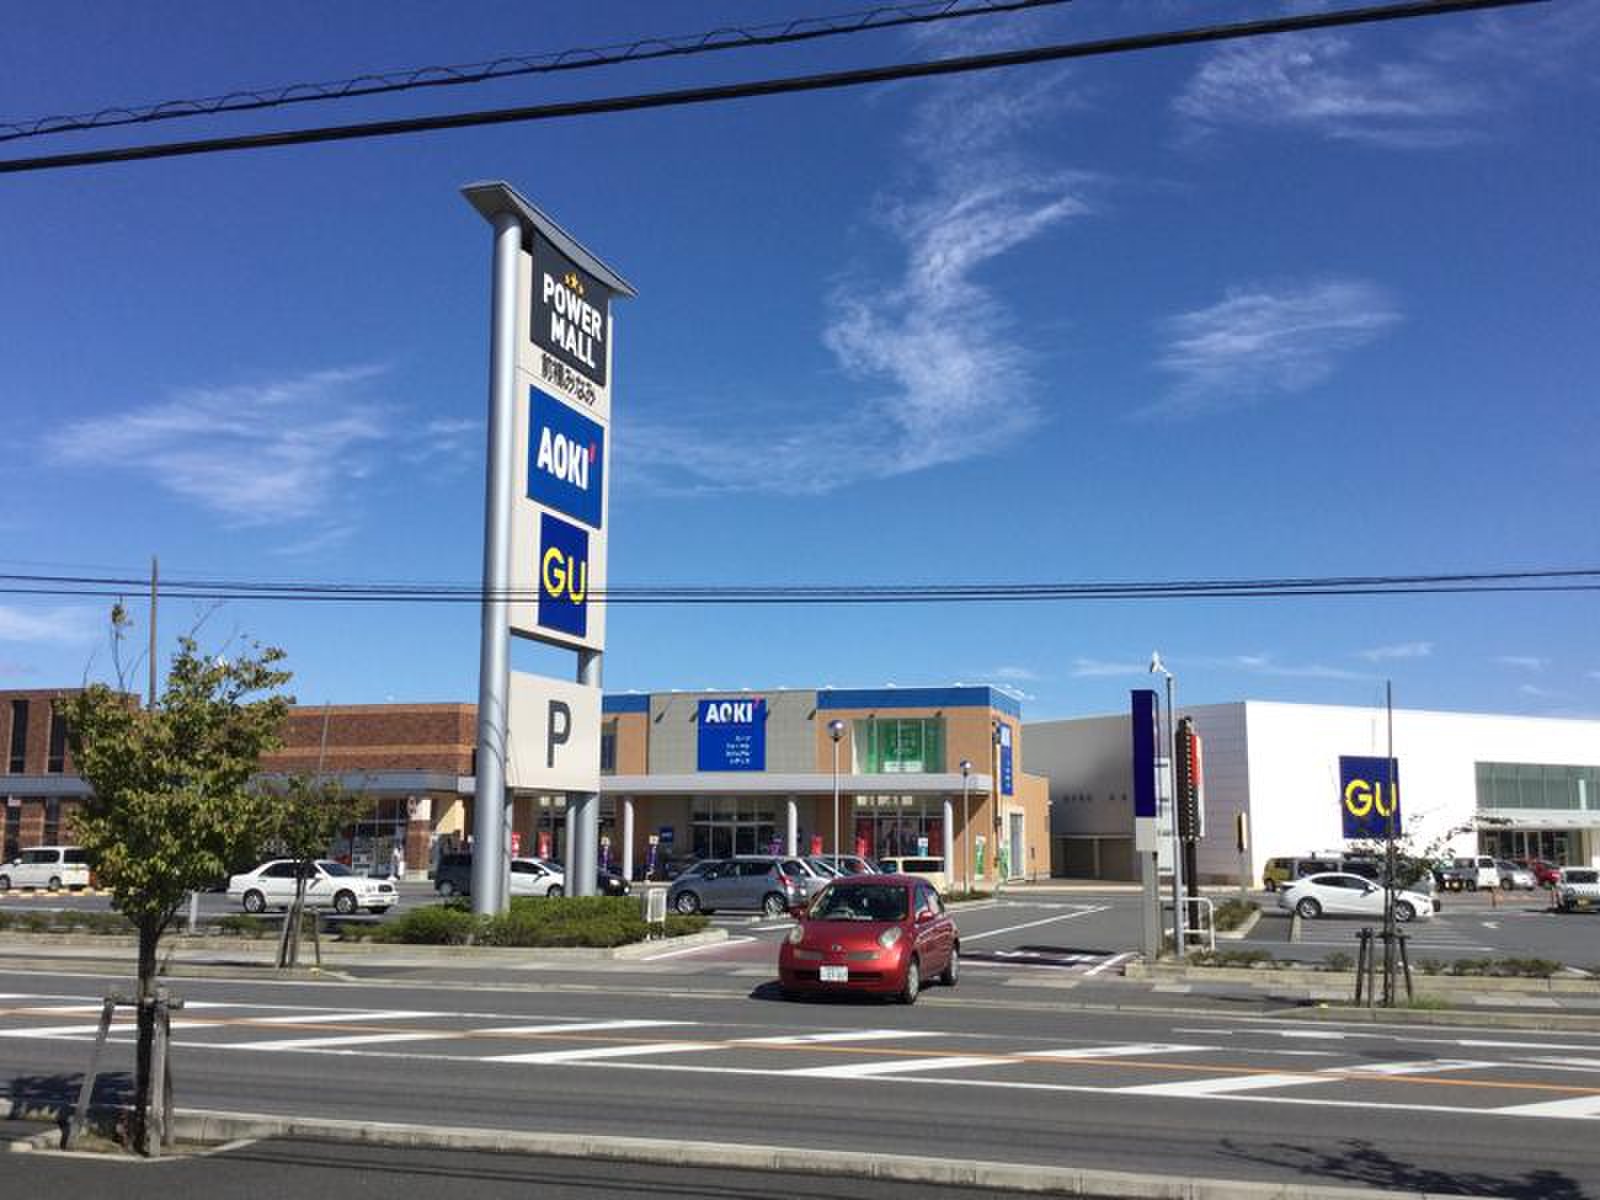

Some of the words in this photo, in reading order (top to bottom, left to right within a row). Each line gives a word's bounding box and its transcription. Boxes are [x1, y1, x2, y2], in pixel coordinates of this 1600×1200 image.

[543, 272, 602, 342] POWER
[550, 311, 596, 369] MALL
[543, 547, 587, 605] GU
[547, 699, 571, 768] P
[1345, 778, 1397, 816] GU
